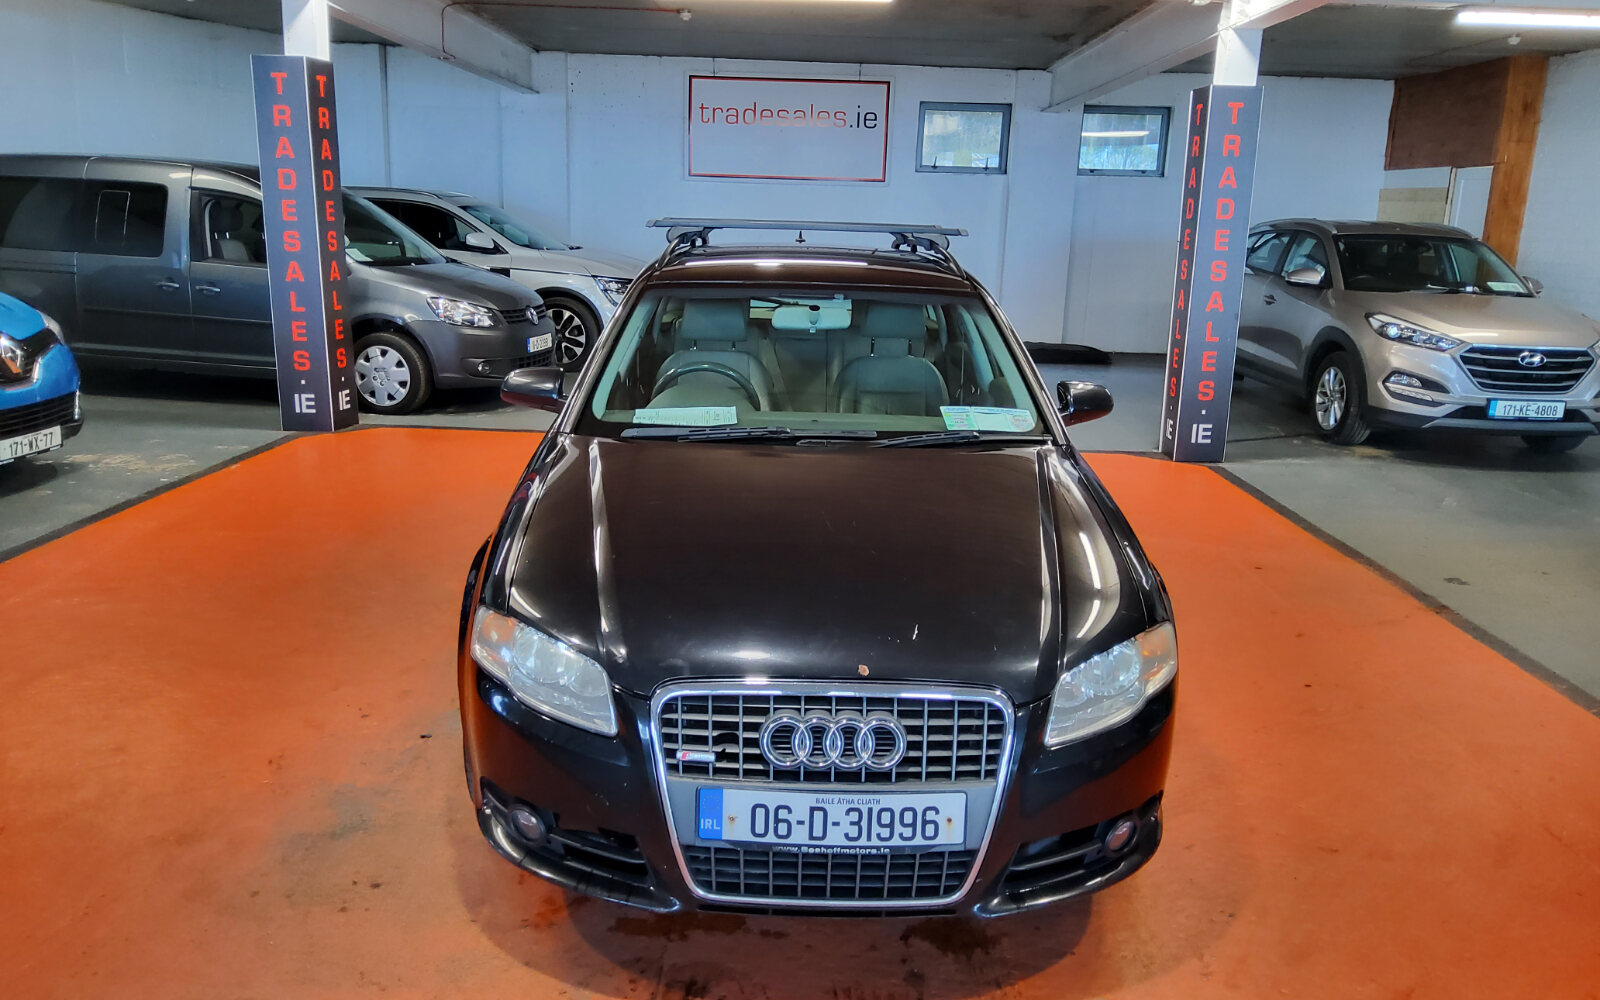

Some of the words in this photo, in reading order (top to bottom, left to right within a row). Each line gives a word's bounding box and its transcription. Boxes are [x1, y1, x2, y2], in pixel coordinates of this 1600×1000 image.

[699, 101, 878, 129] tradesales.ie
[1503, 404, 1558, 416] 171-KE-4808
[10, 432, 53, 457] 171-WX-77
[815, 797, 835, 805] BAILE
[857, 798, 881, 806] CLIATH
[701, 818, 720, 830] IRL
[750, 803, 940, 842] 06-D-31996
